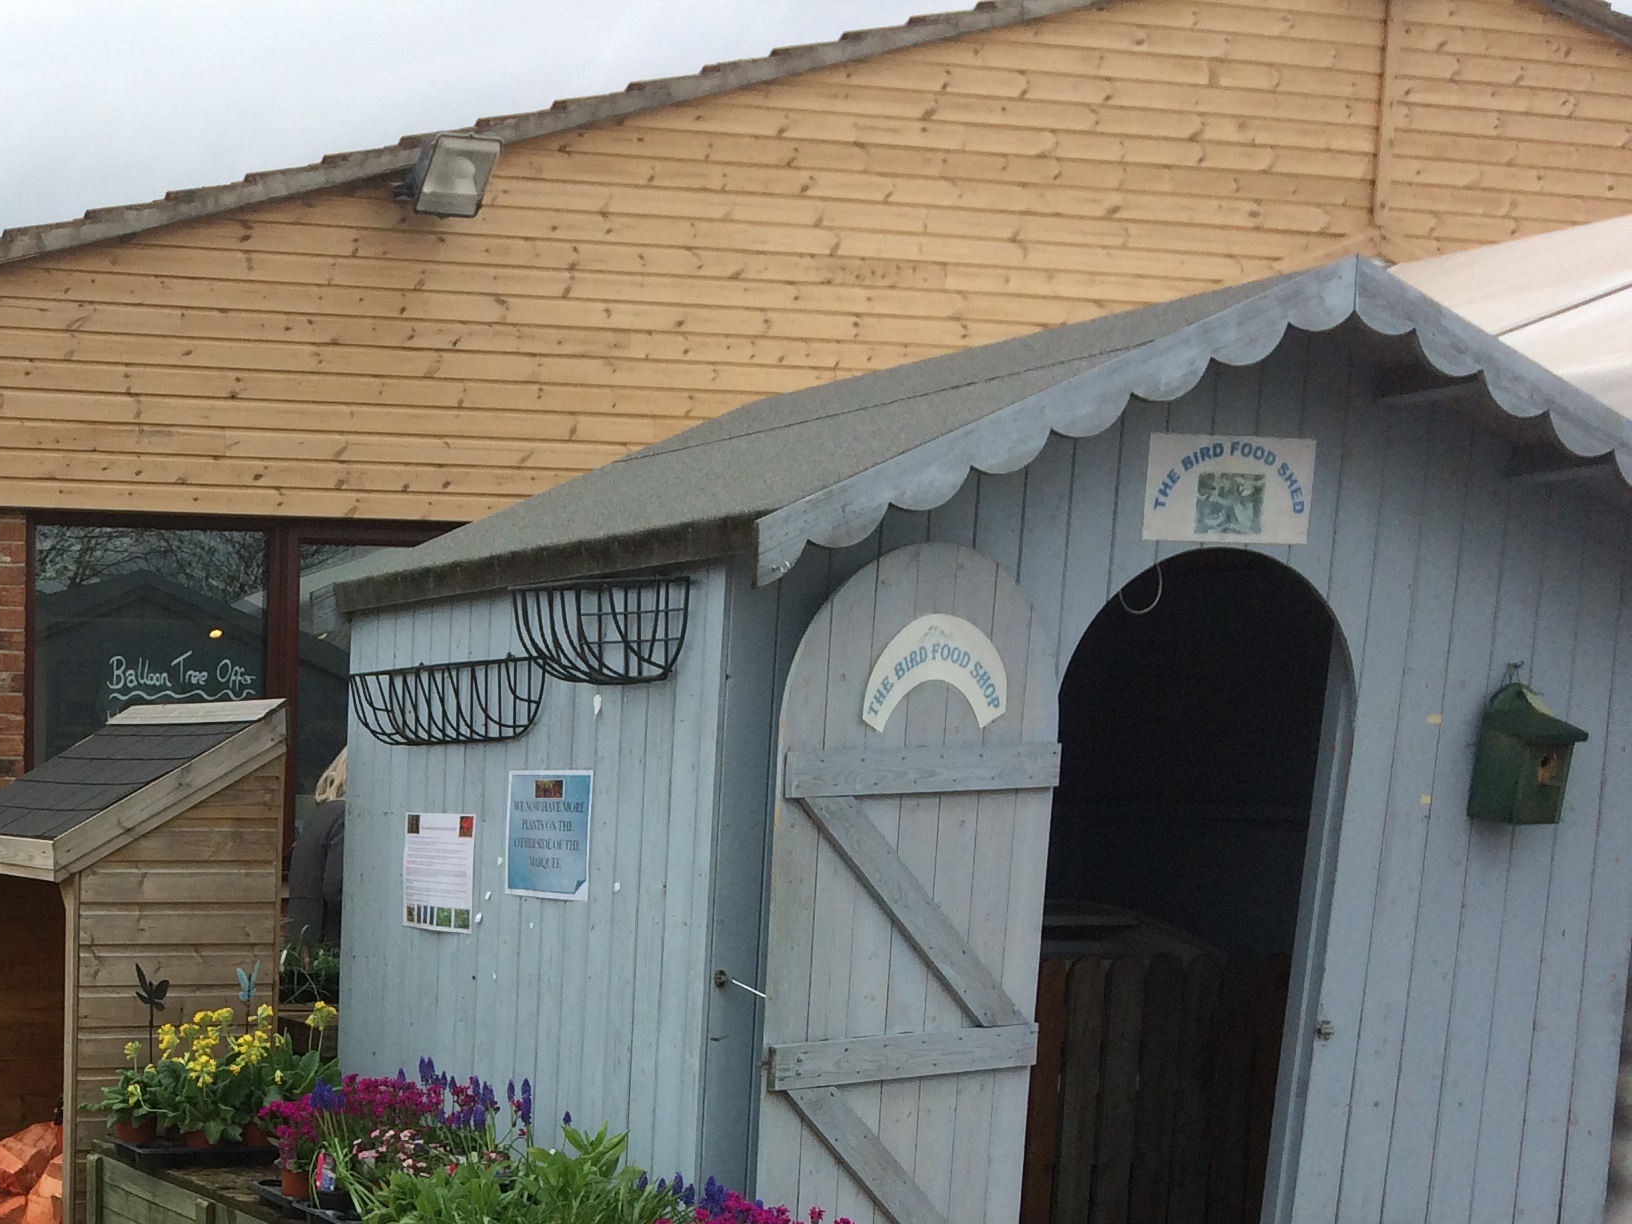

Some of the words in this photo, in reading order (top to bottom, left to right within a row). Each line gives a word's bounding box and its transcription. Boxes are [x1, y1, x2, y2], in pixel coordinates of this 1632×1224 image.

[1153, 468, 1181, 511] THE
[1180, 442, 1225, 472] BIRD
[1229, 441, 1277, 466] FOOD
[1277, 462, 1305, 514] SHED
[106, 655, 172, 689] Balloon
[170, 650, 208, 685] Tree
[868, 675, 894, 717] THE
[893, 645, 928, 681] BIRD
[930, 642, 971, 668] FOOD
[969, 661, 1000, 709] SHOP
[521, 818, 544, 830] PLANTS
